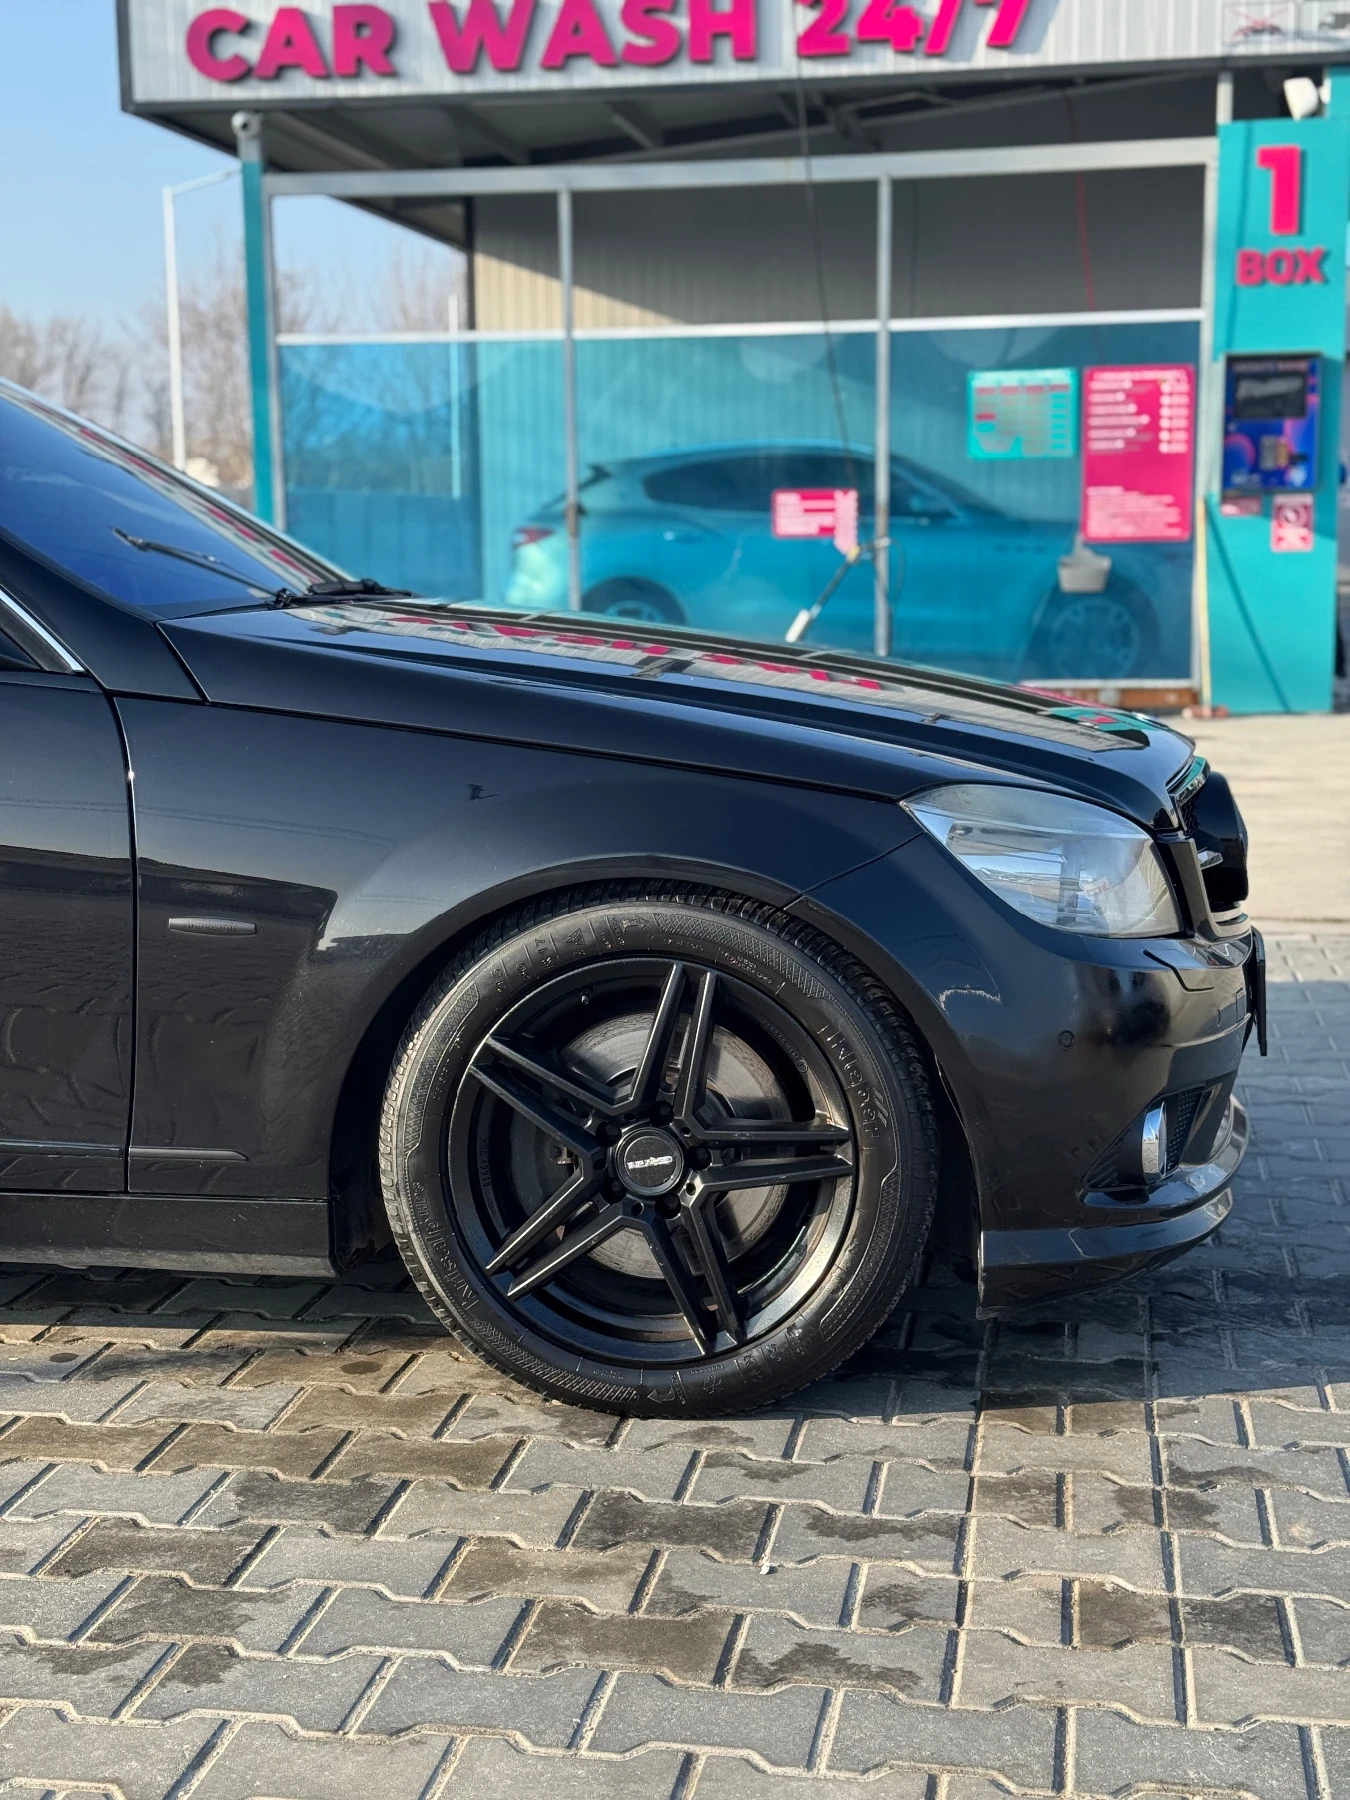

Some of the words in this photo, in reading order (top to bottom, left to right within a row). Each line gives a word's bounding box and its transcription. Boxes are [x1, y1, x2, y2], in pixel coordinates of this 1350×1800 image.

[186, 3, 397, 83] CAR
[427, 0, 757, 71] WASH
[795, 0, 1030, 56] 24/7
[1256, 144, 1300, 235] 1
[1235, 247, 1327, 286] BOX
